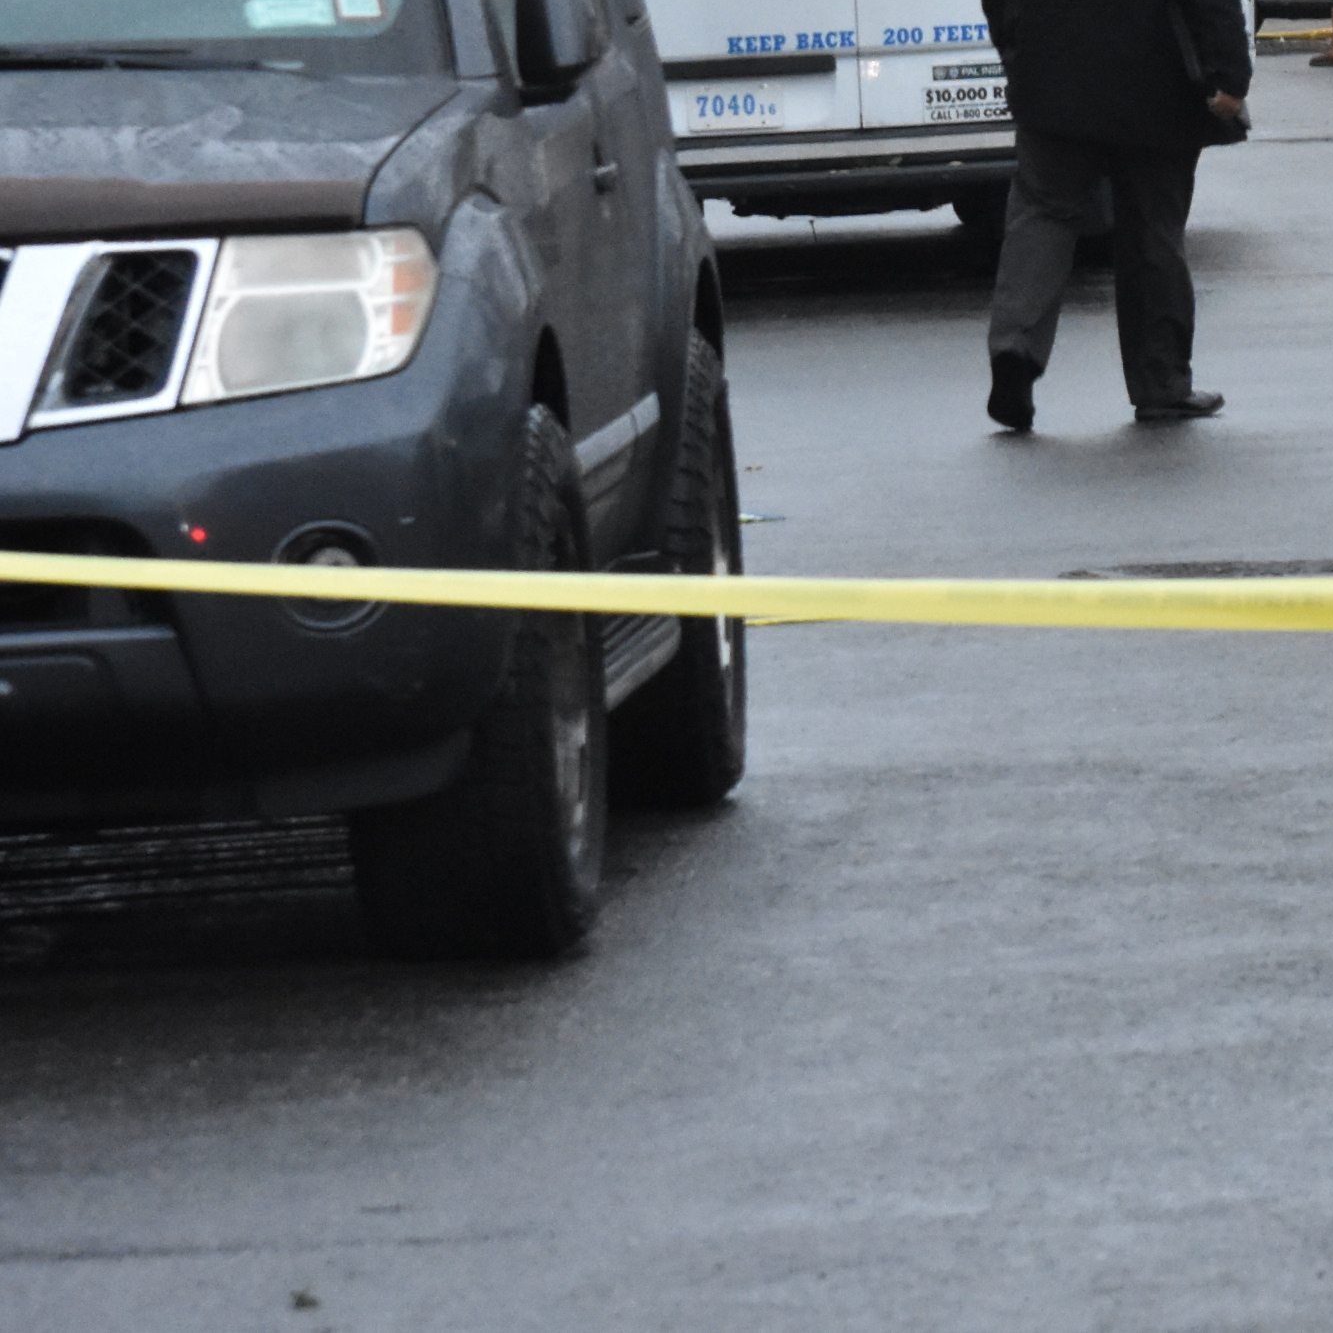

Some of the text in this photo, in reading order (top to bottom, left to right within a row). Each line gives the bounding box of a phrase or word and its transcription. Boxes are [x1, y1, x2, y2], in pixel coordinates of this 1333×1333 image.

[727, 24, 990, 55] KEEP BACK 200 FEET
[695, 93, 757, 118] 7040
[925, 86, 988, 105] $10,000
[930, 109, 953, 121] CALL
